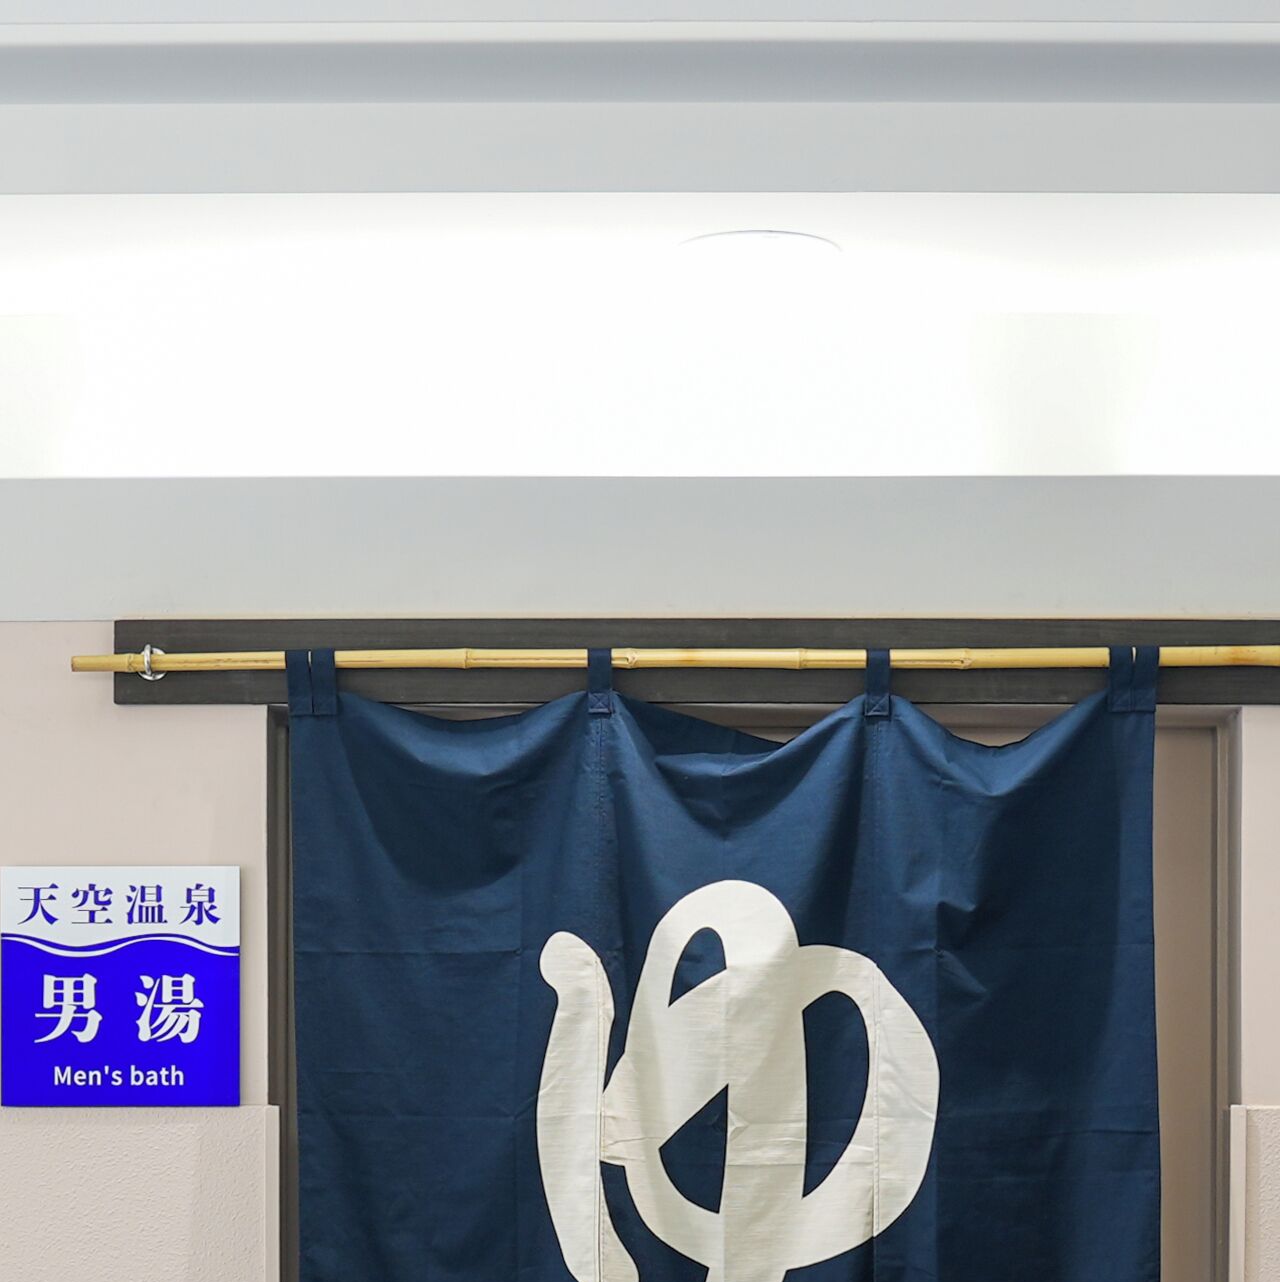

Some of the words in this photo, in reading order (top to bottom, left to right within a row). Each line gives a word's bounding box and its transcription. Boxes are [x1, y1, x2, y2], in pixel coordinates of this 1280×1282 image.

[17, 883, 221, 925] 天空温泉
[34, 973, 204, 1044] 男湯
[53, 1065, 123, 1086] Men's
[130, 1065, 185, 1086] bath
